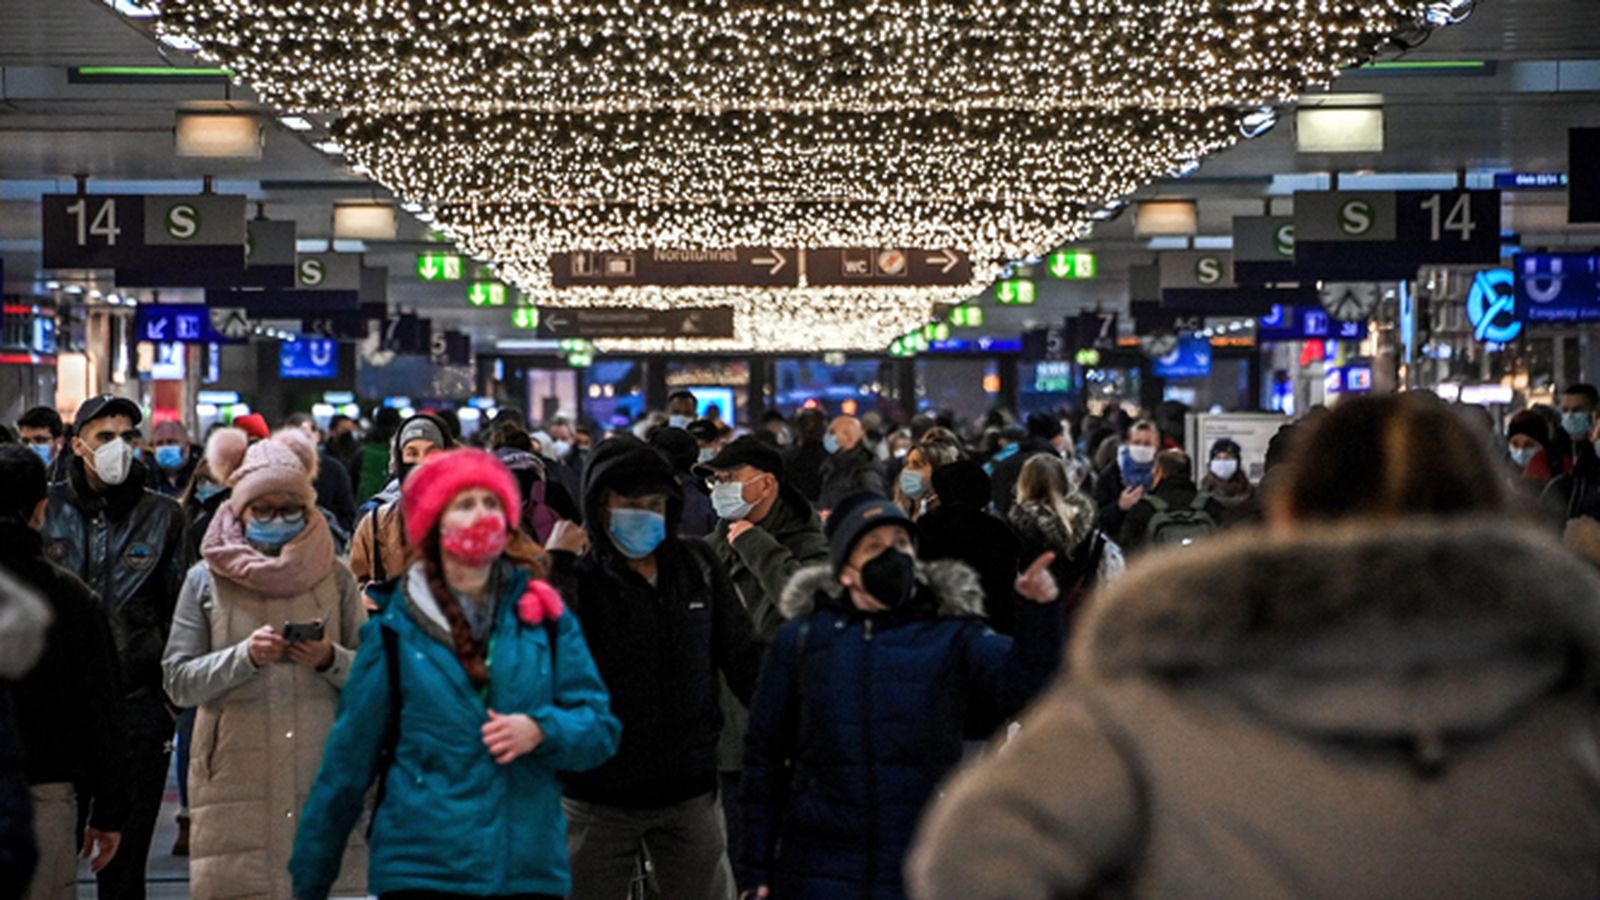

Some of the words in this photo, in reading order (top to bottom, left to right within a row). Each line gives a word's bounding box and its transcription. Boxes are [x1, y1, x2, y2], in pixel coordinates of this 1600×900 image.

[66, 199, 121, 246] 14
[169, 205, 197, 238] S
[1341, 202, 1369, 234] S
[1420, 193, 1475, 242] 14
[301, 260, 324, 285] S
[846, 260, 868, 273] WC
[1199, 257, 1221, 285] S
[1525, 257, 1563, 304] U
[387, 315, 401, 340] 7
[1097, 313, 1114, 338] 7
[310, 340, 331, 367] U
[431, 332, 446, 355] 5
[1046, 331, 1063, 353] 5
